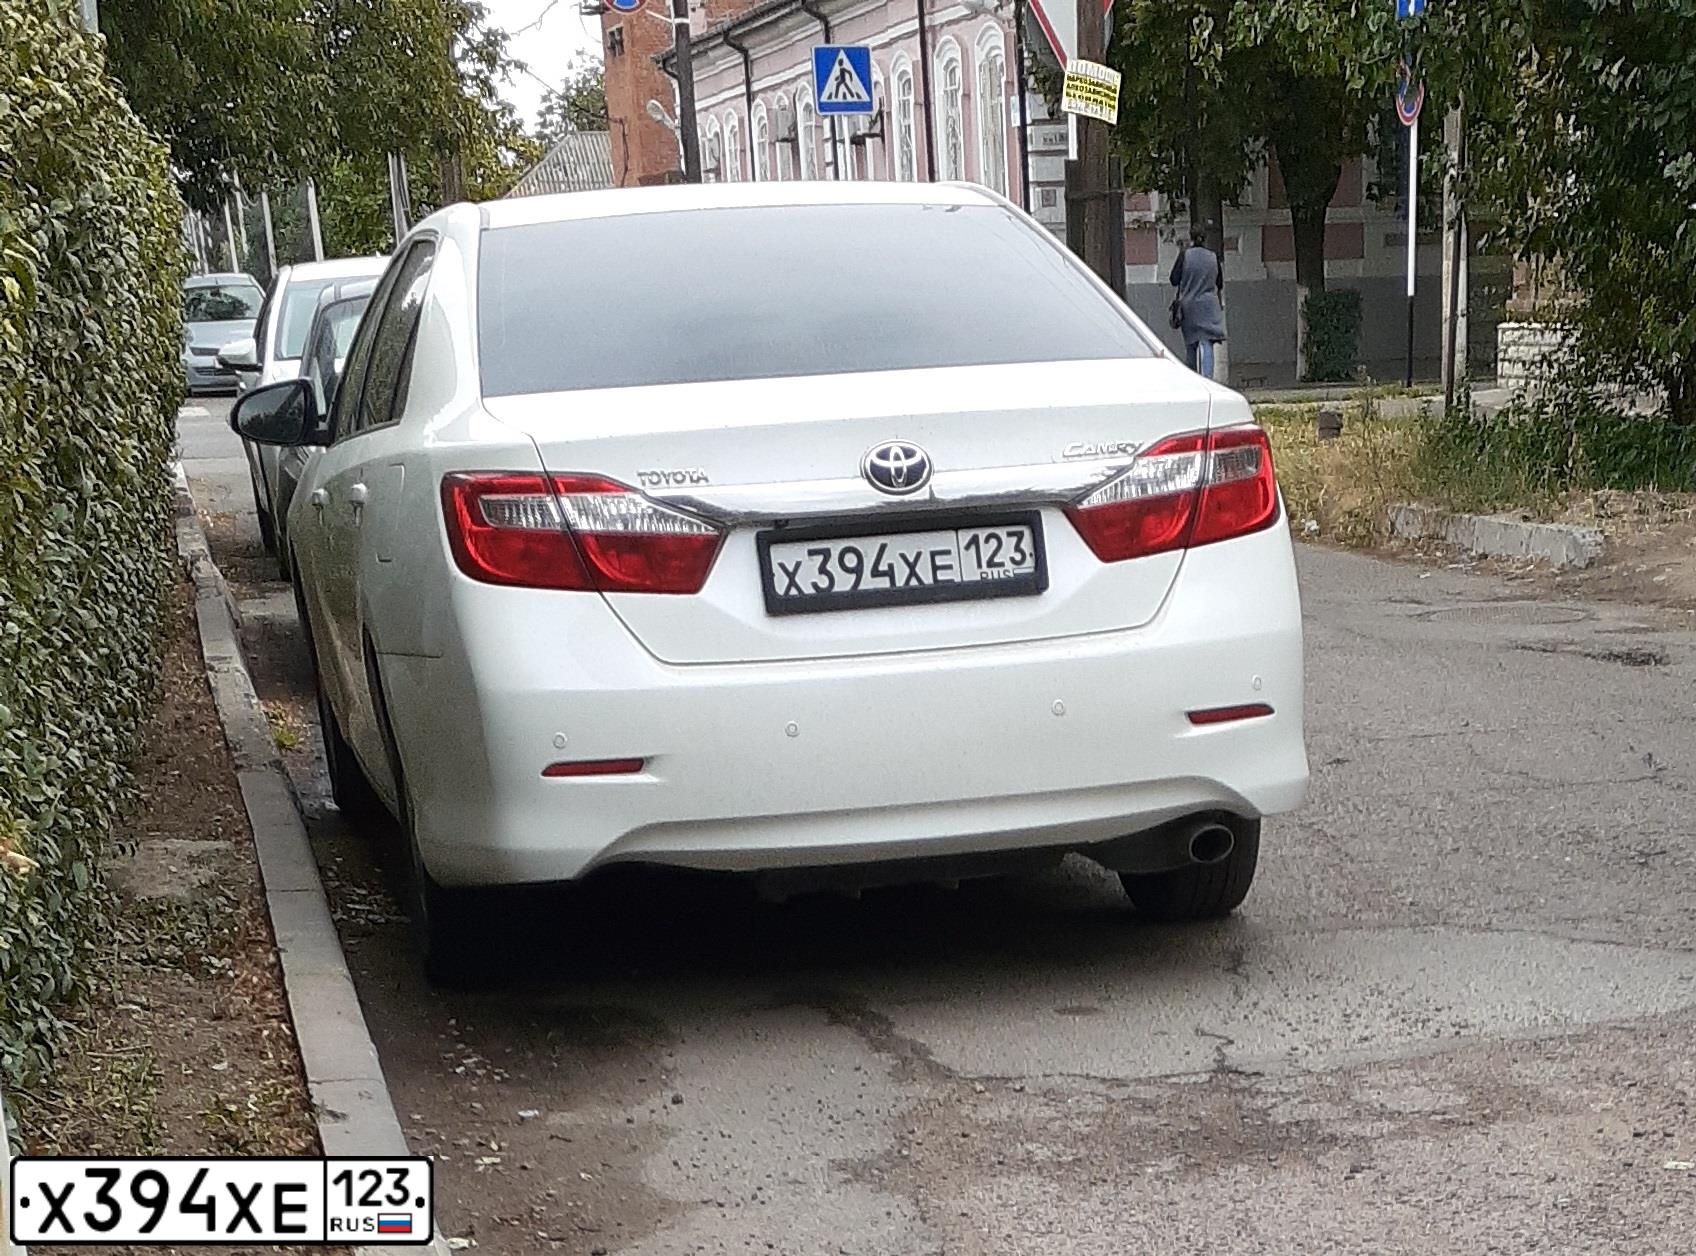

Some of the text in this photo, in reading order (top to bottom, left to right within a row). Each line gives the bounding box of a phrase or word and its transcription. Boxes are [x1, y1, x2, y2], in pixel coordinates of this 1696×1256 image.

[637, 468, 710, 487] TOYOTA
[777, 529, 1027, 597] Х394ХЕ 123
